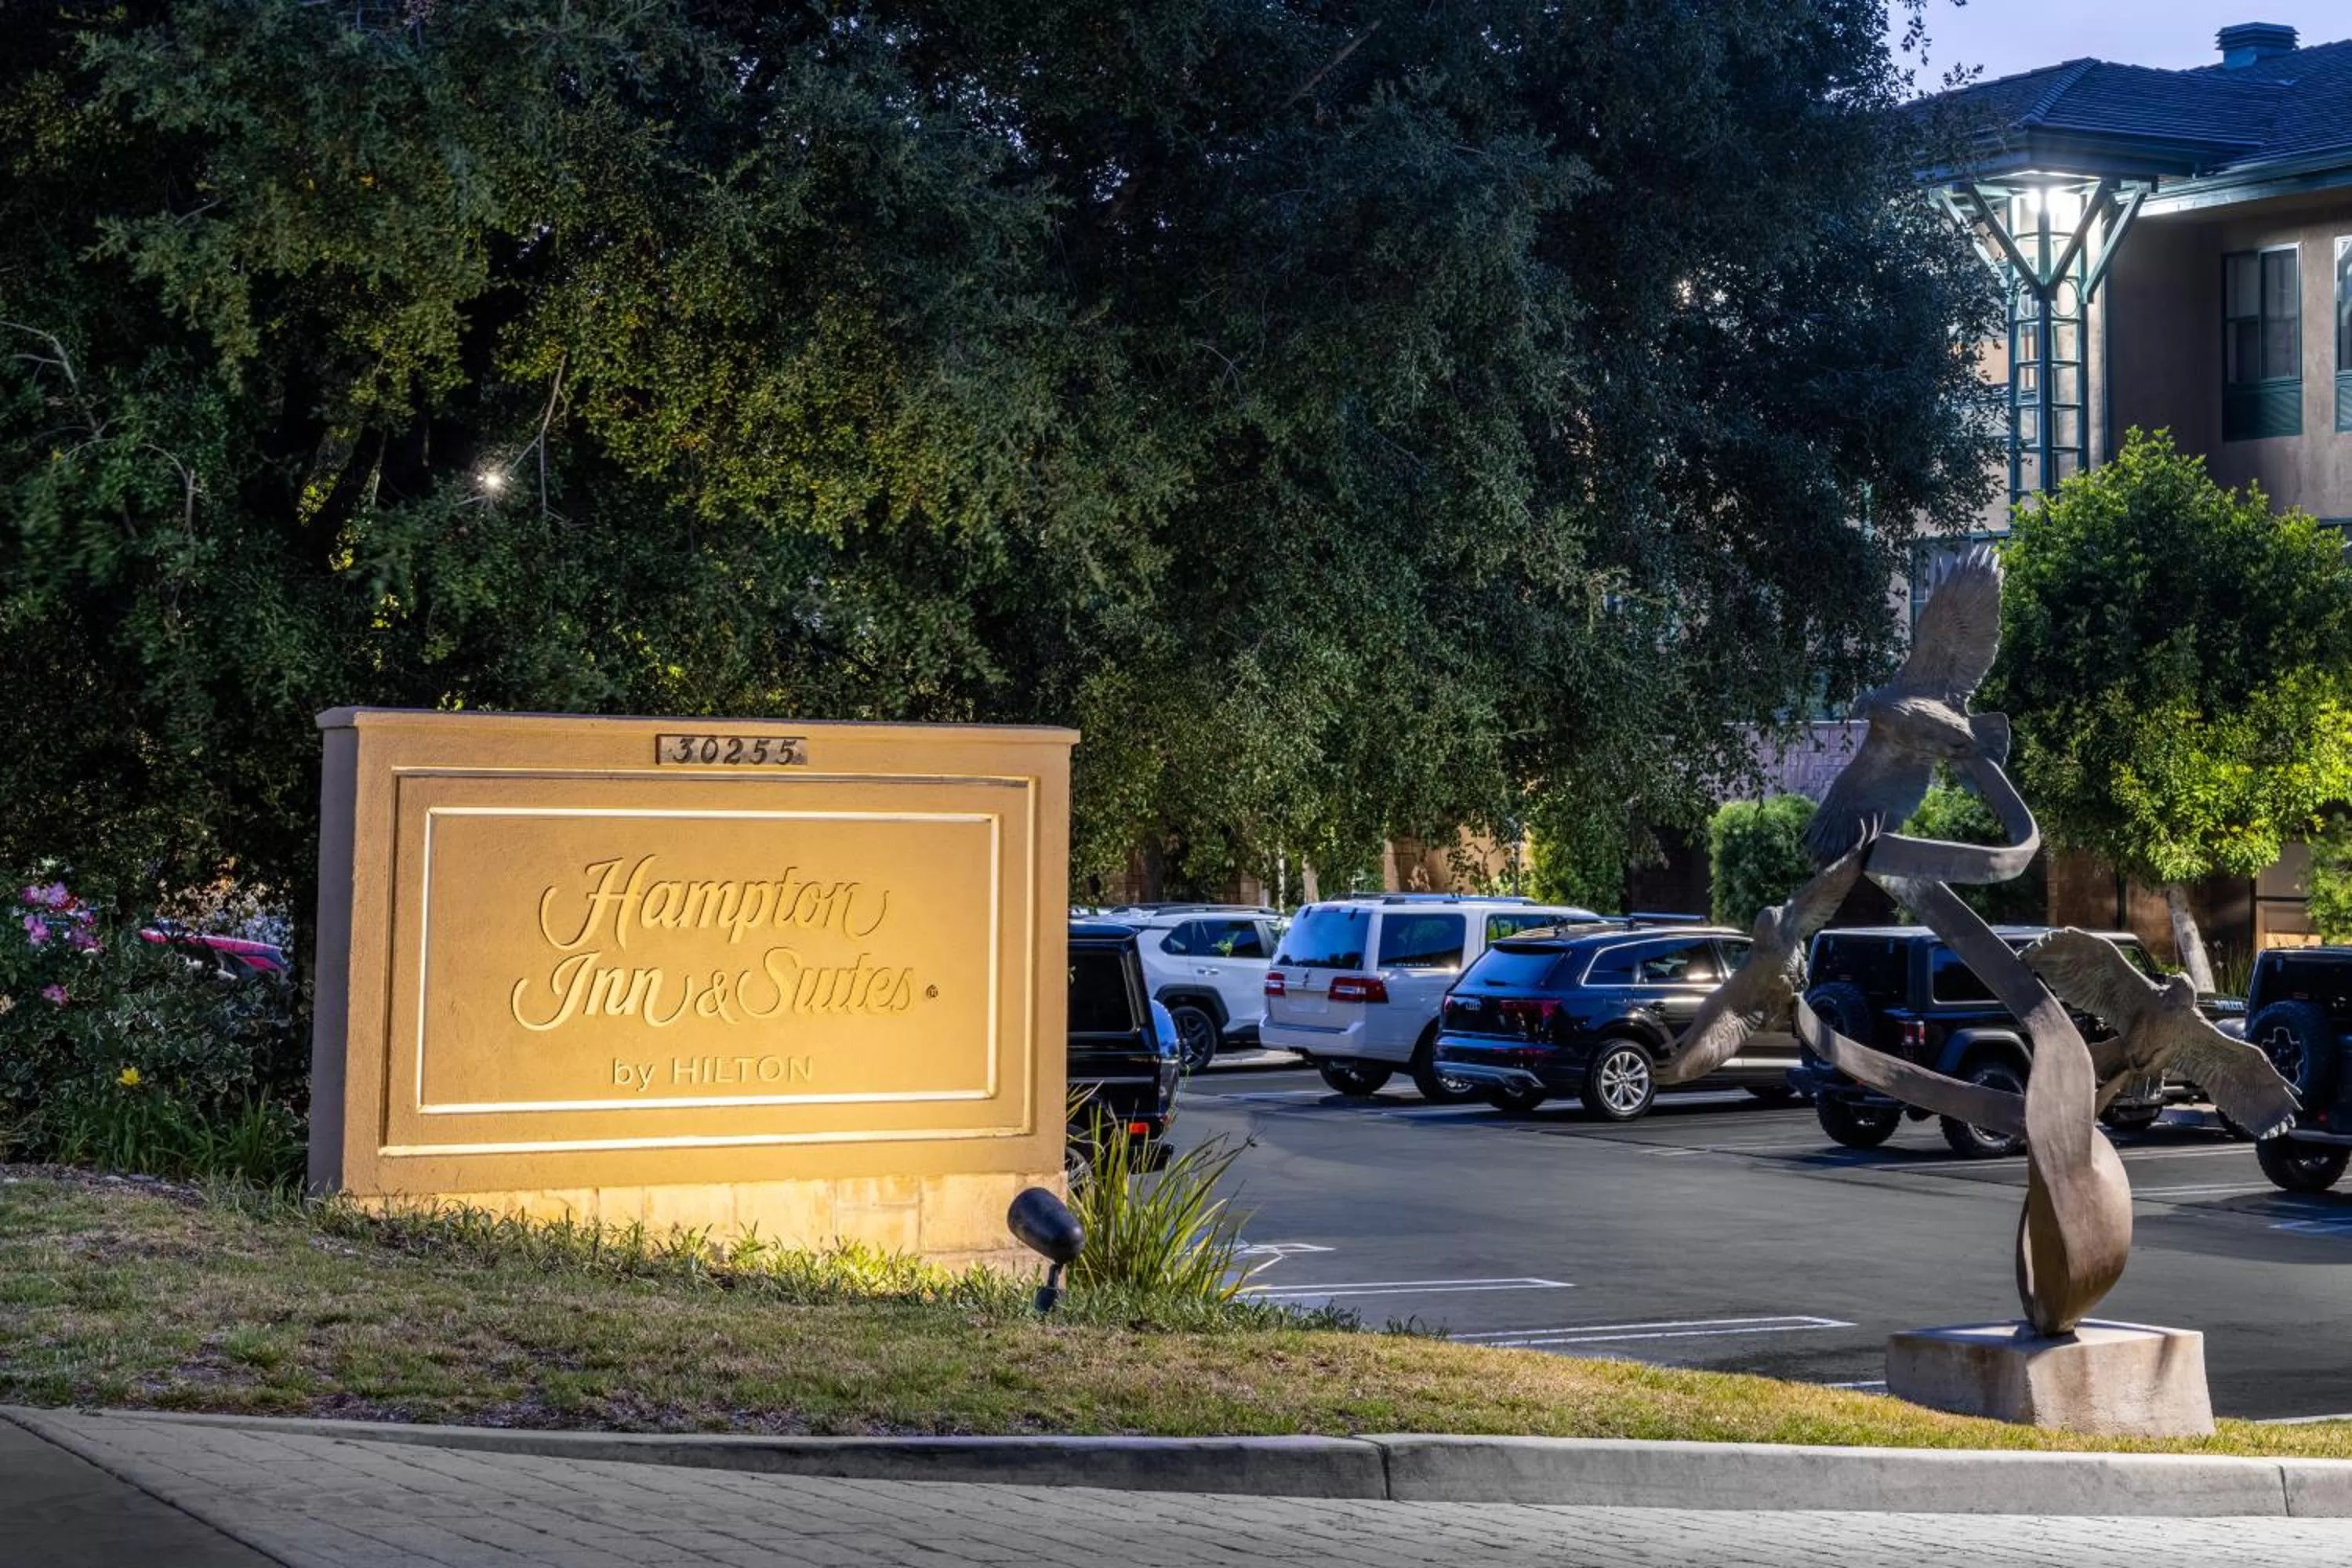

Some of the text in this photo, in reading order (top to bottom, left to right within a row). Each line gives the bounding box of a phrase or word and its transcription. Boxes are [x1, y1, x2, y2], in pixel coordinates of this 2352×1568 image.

[673, 736, 797, 765] 30255
[539, 853, 890, 950] Hampton
[511, 946, 915, 1032] Inn & Suites
[612, 1055, 815, 1092] by HILTON
